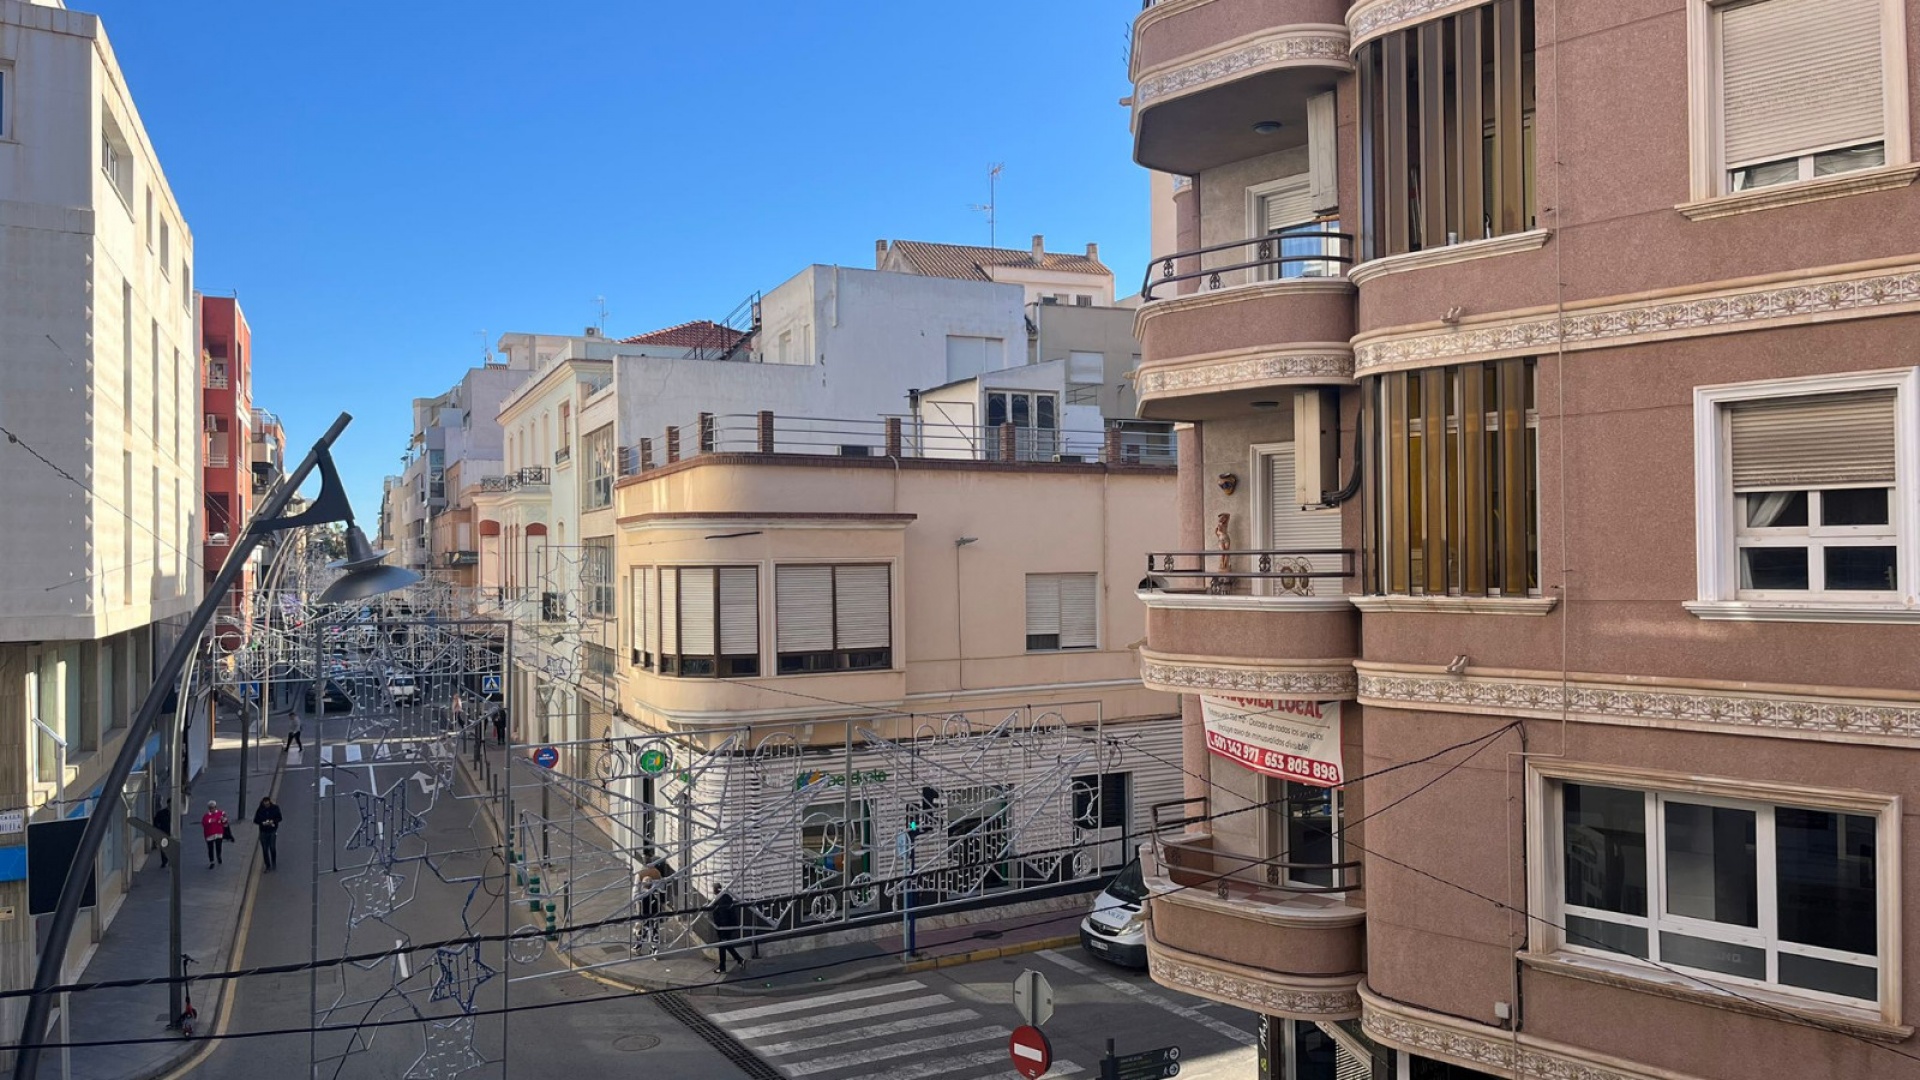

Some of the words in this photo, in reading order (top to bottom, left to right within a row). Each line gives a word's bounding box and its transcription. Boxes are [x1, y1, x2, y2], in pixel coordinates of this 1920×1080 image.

[1278, 699, 1323, 719] LOCAL
[1265, 751, 1284, 769] 653
[1288, 757, 1310, 775] 805
[1313, 762, 1338, 781] 898
